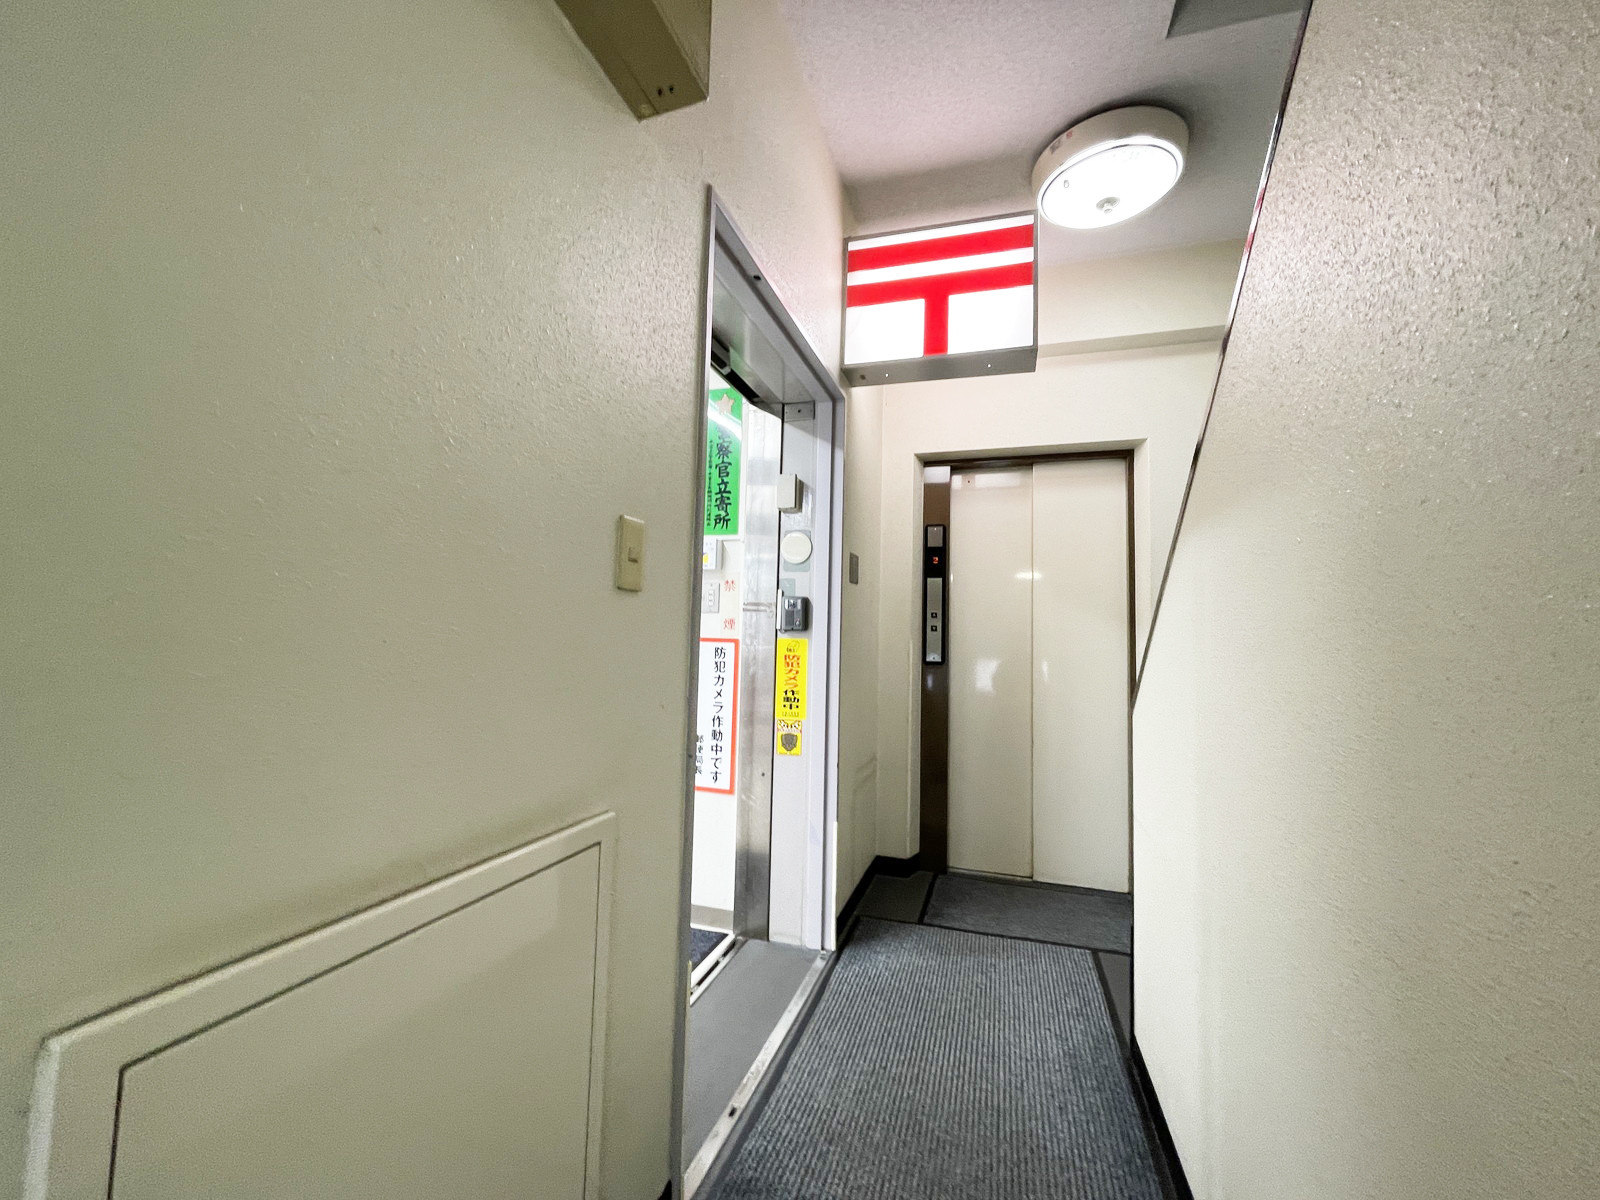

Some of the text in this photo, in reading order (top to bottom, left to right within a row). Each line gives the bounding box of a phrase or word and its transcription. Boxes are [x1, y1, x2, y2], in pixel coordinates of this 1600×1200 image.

[723, 579, 736, 630] 禁煙
[783, 654, 801, 710] 防犯カメラ作動中
[710, 646, 727, 784] 防犯カメラ作動中です
